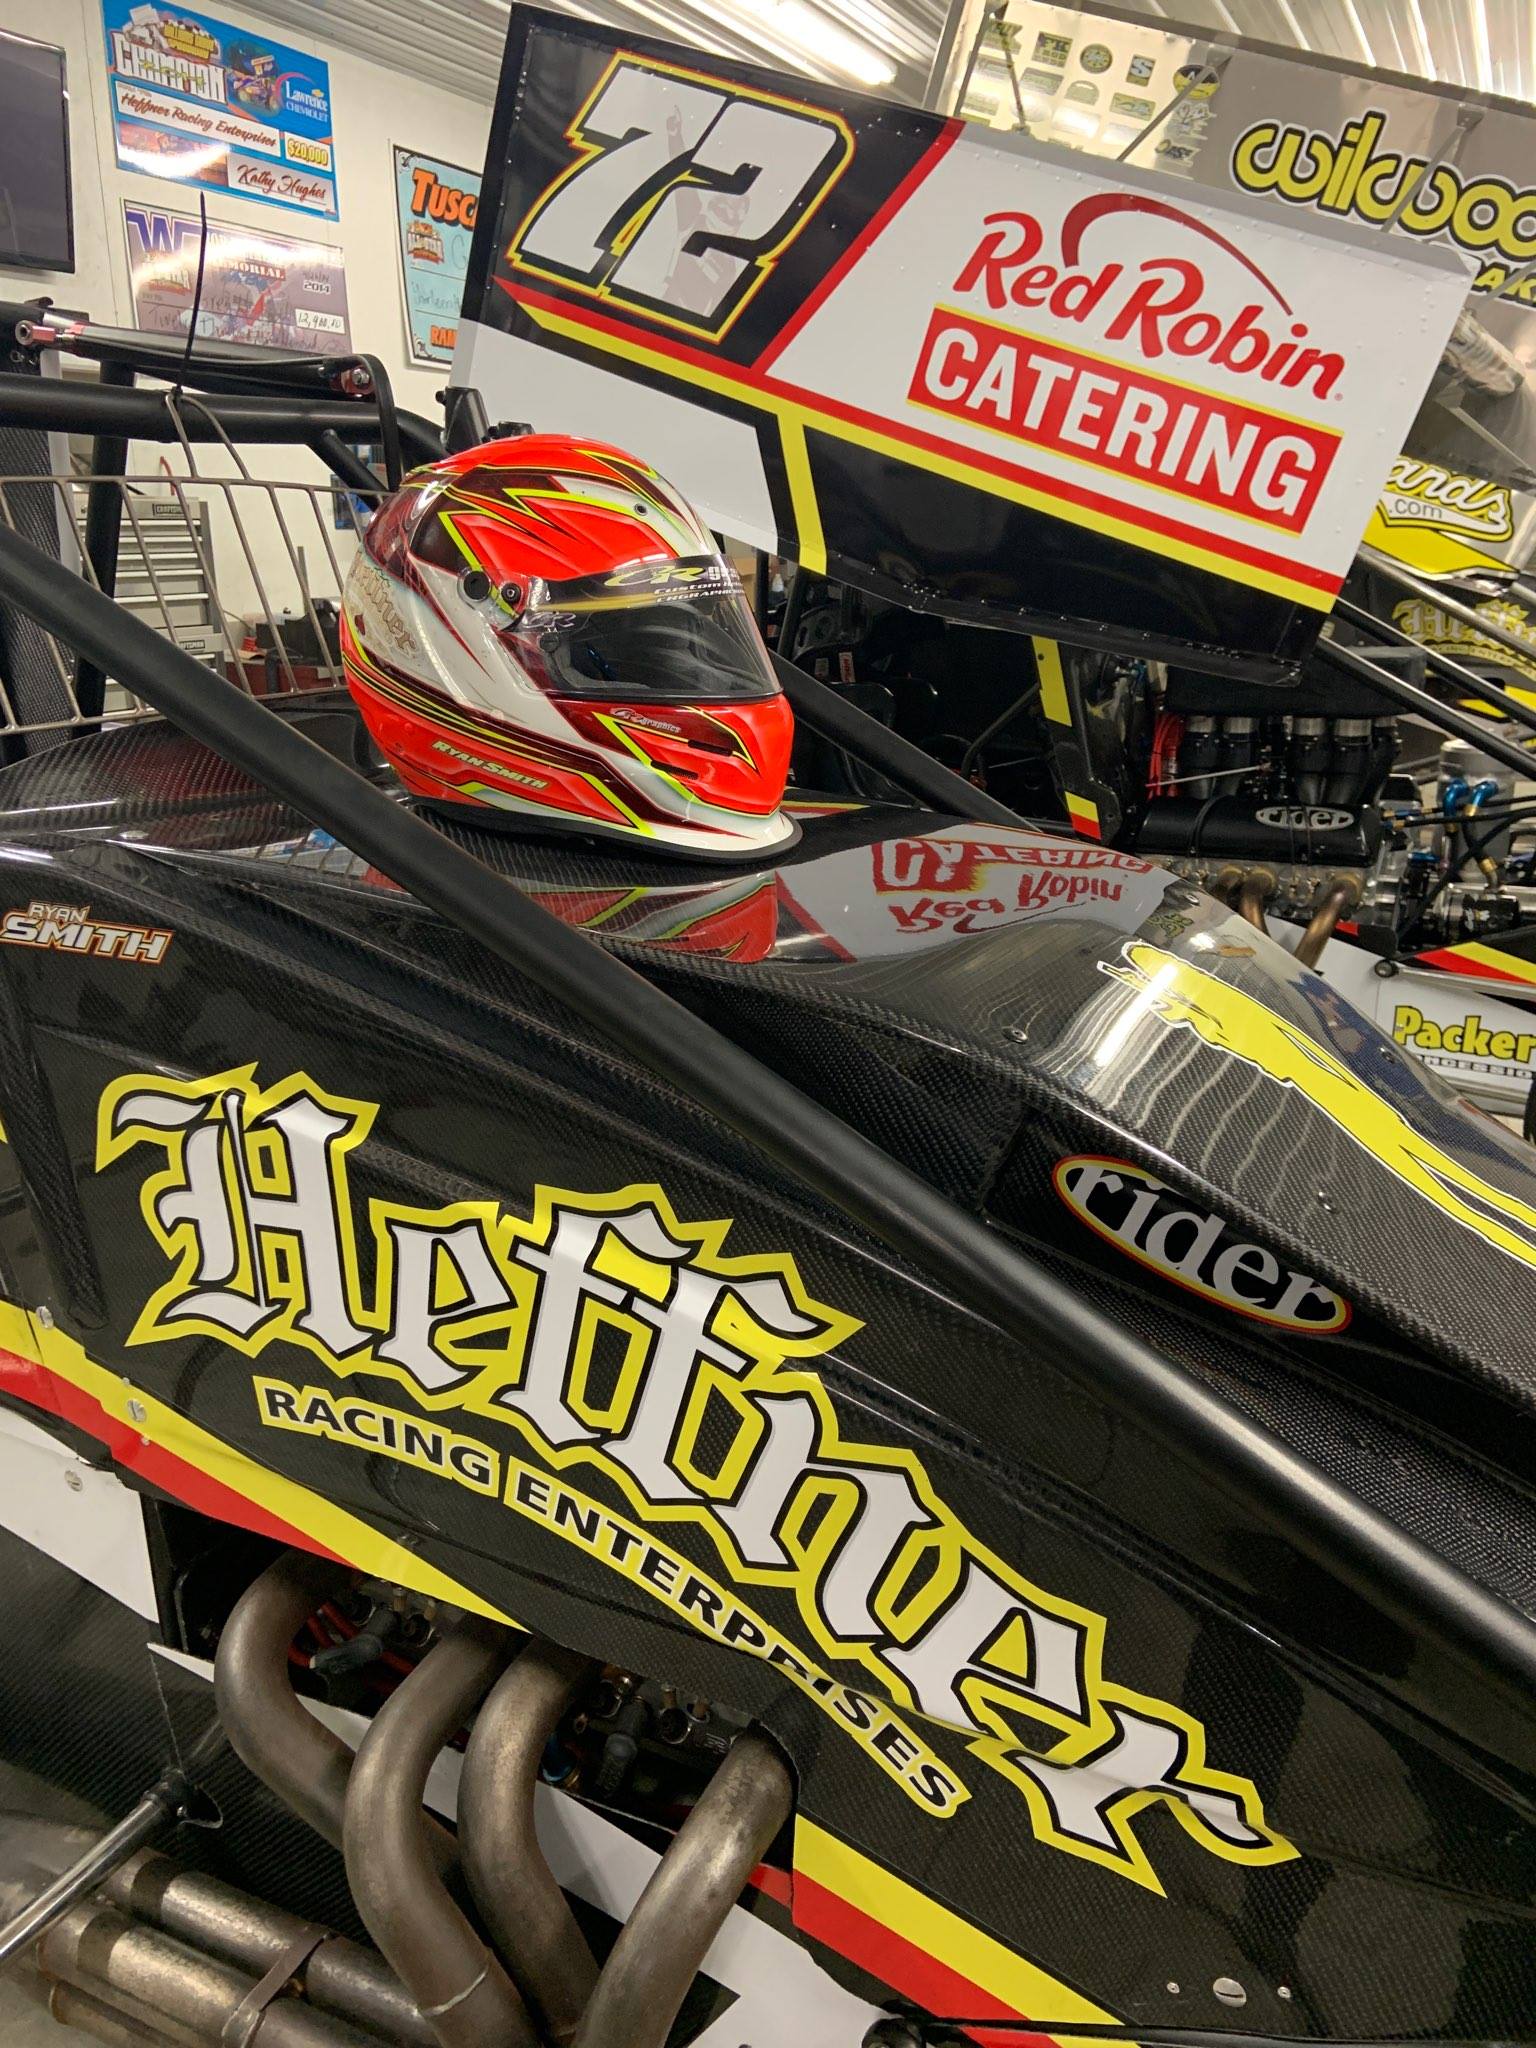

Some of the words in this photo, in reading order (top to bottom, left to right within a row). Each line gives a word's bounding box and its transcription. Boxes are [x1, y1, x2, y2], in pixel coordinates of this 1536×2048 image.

[121, 92, 170, 117] Heffner
[171, 105, 214, 132] Racing
[215, 120, 277, 148] Enterprises
[286, 80, 329, 112] Lawrence
[287, 137, 329, 167] $20,000
[236, 164, 276, 194] Kathy
[277, 175, 327, 202] Hughes
[411, 166, 478, 227] TUSC
[515, 60, 846, 328] 72
[953, 211, 1124, 324] Red
[1104, 257, 1346, 401] Robin
[924, 326, 1317, 518] CATERING
[1388, 497, 1444, 519] .com
[432, 740, 483, 767] RYAN
[480, 760, 550, 790] SMITH
[1257, 806, 1353, 830] rider
[0, 913, 172, 963] SMITH
[28, 903, 90, 923] RYAN
[1066, 1163, 1340, 1322] rider
[262, 1386, 492, 1487] RACING
[108, 1082, 1276, 1862] Heffner
